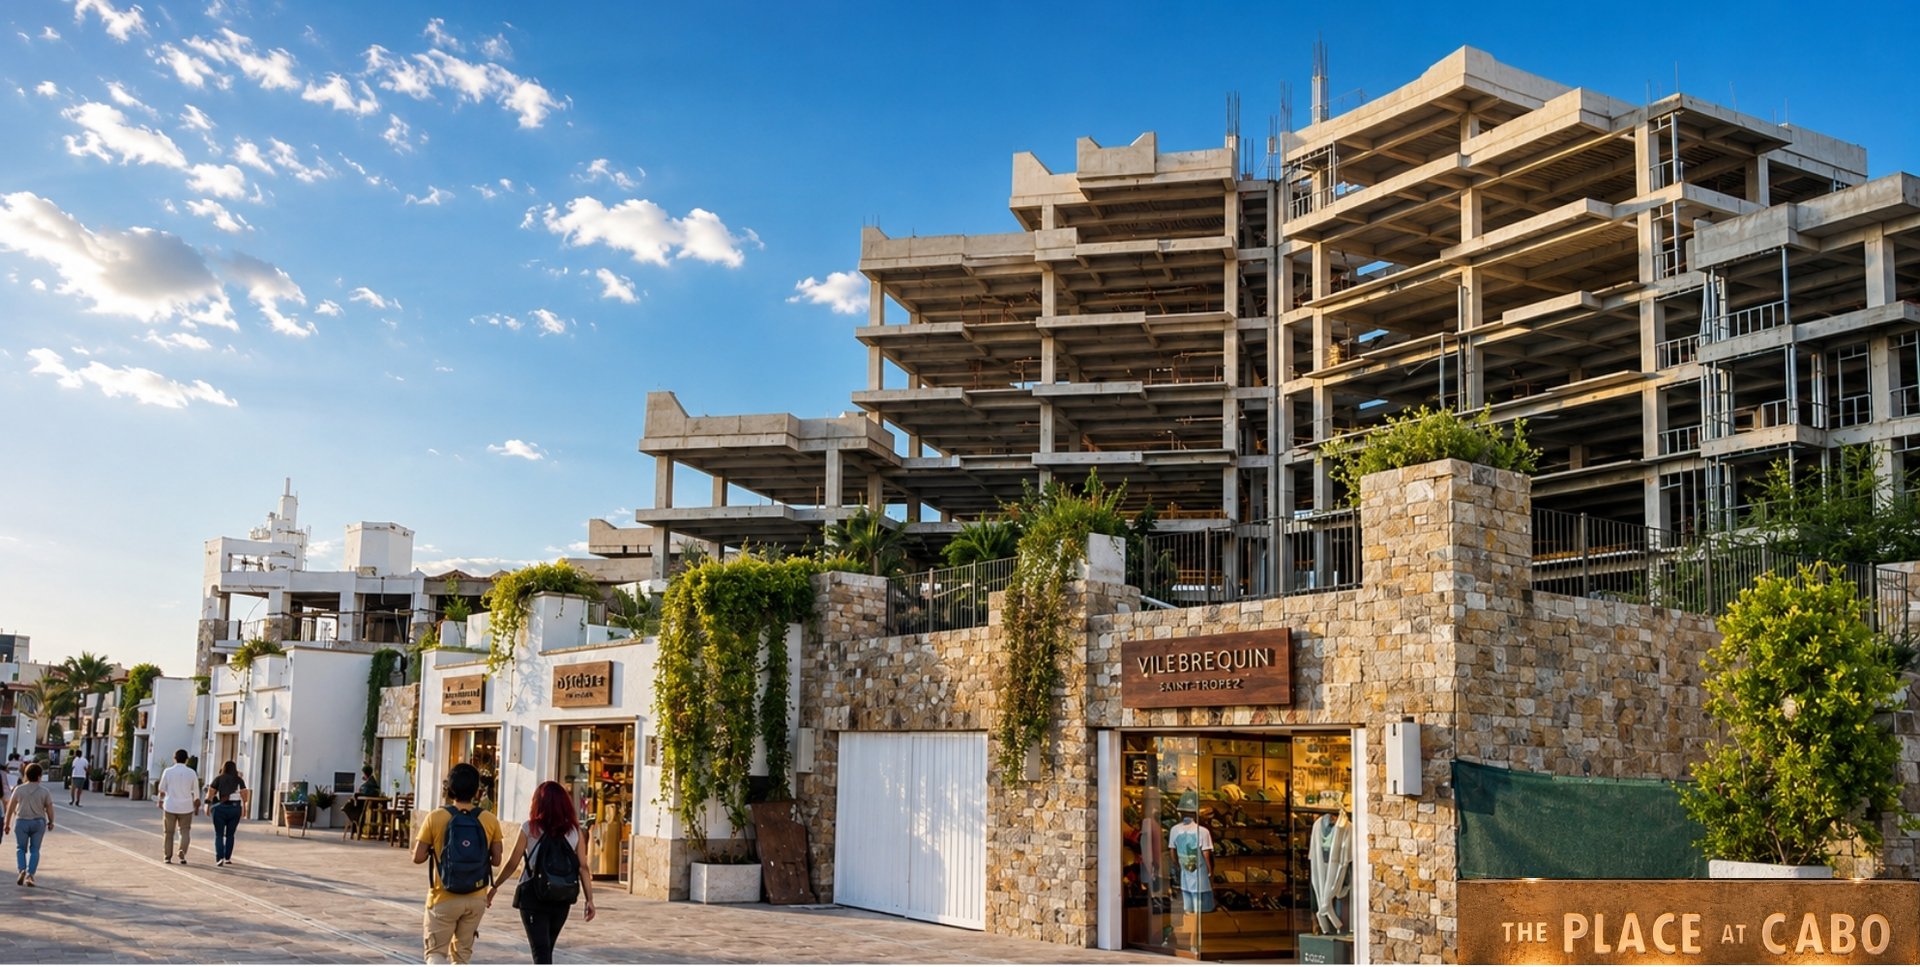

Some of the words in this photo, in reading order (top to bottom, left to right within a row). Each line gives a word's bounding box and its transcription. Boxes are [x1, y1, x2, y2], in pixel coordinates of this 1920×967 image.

[1137, 648, 1270, 674] VILEBREQUIN
[1501, 921, 1548, 943] THE
[1563, 912, 1702, 954] PLACE
[1720, 923, 1748, 944] AT
[1761, 912, 1891, 955] CABO
